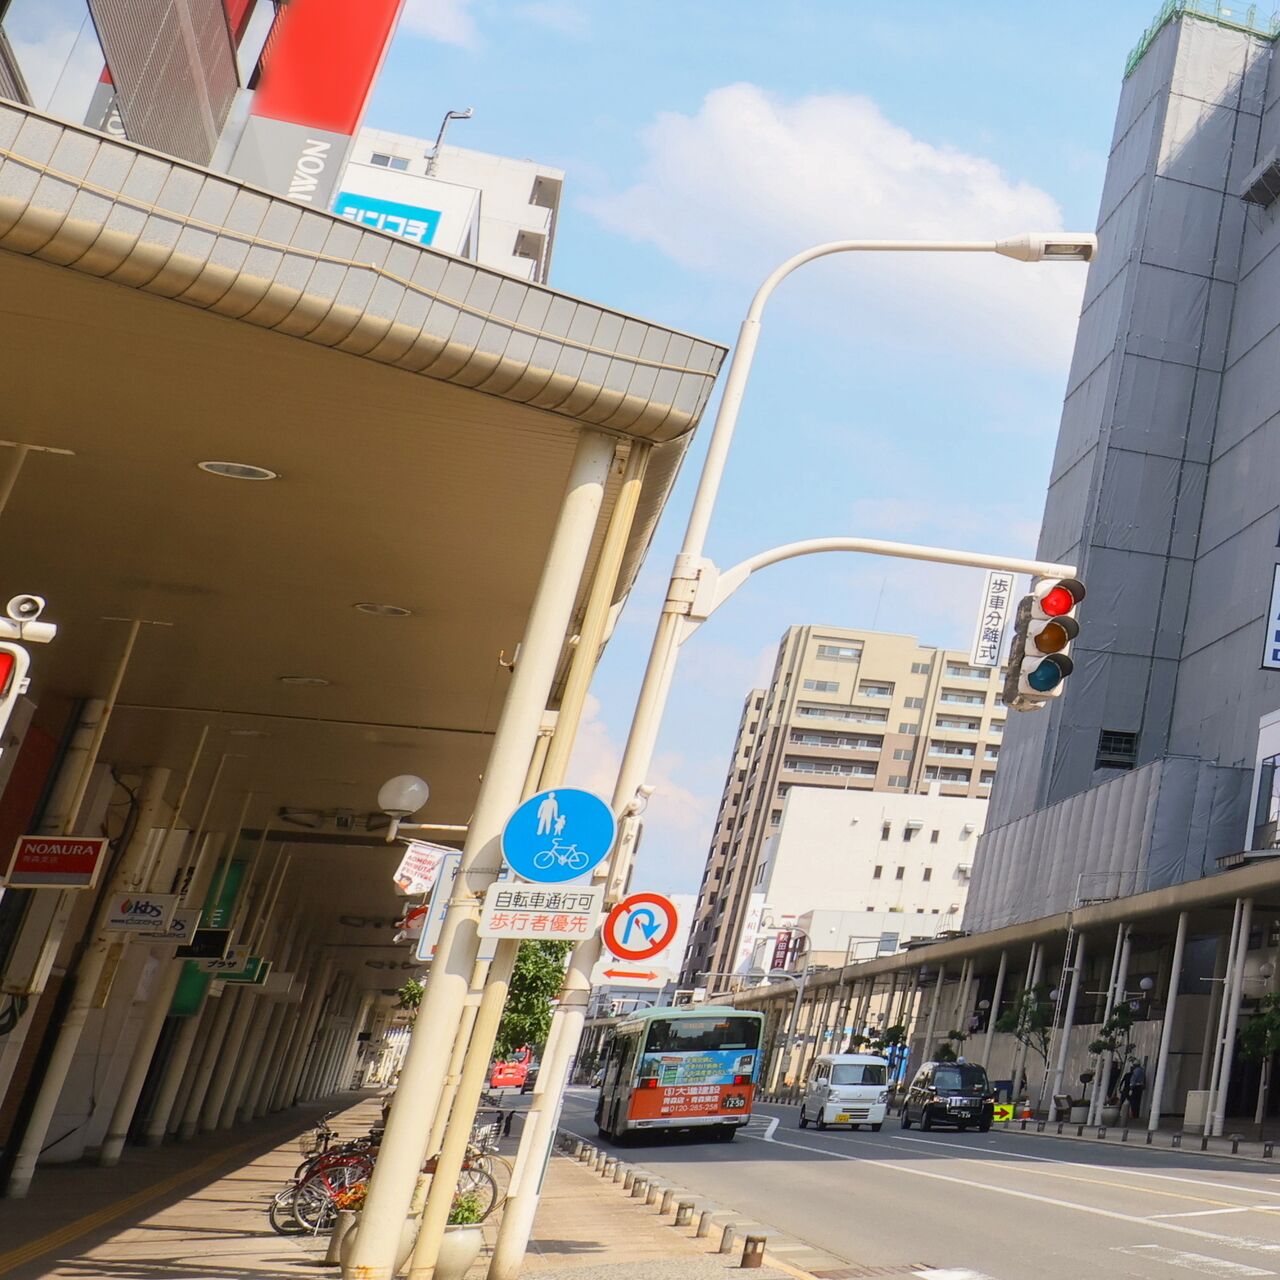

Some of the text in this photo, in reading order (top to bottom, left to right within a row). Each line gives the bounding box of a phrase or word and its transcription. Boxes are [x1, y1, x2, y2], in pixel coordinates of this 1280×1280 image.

[978, 579, 1009, 660] 歩車分離式
[24, 843, 94, 855] NOMURA
[494, 891, 595, 910] 自転車通行可
[489, 913, 589, 933] 歩行者優先
